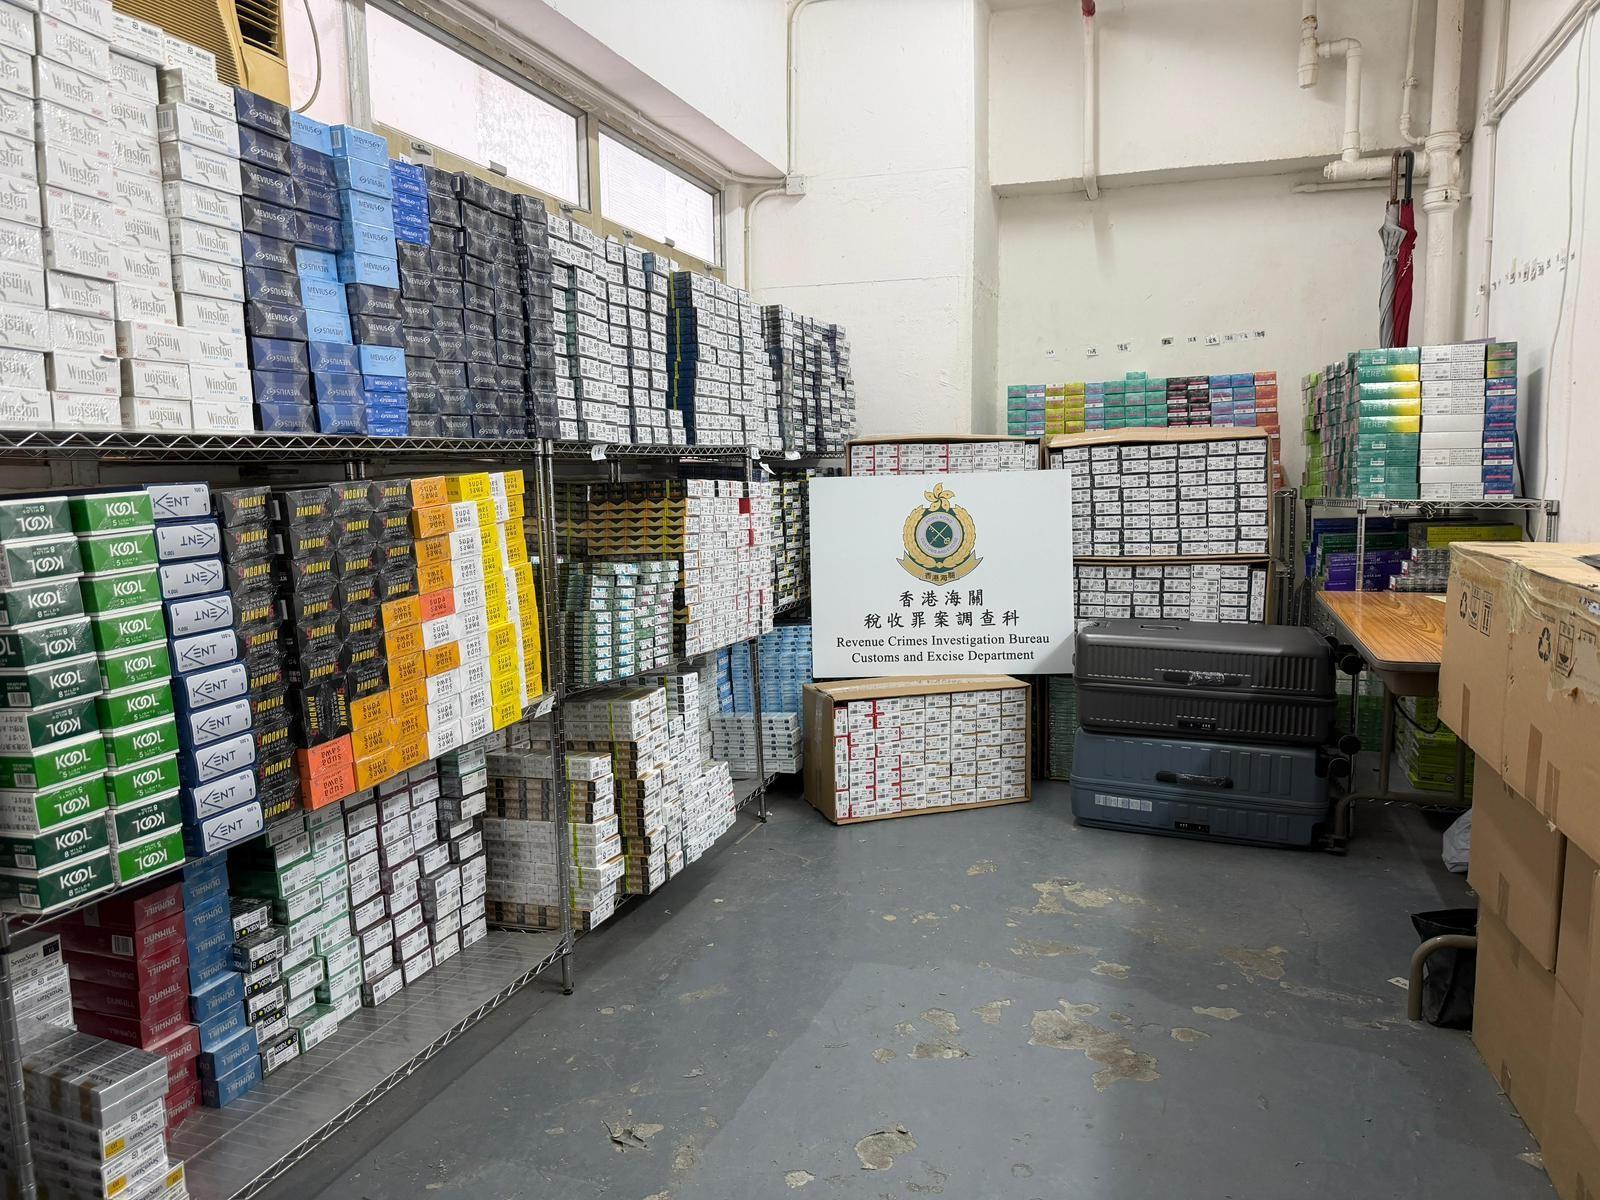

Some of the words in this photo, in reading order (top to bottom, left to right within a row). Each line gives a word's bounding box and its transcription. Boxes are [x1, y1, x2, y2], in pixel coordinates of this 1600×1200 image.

[52, 73, 94, 102] Winston
[112, 67, 148, 91] Winston
[111, 104, 148, 128] Winston
[259, 112, 282, 128] MEVIUS
[192, 116, 224, 139] Winston
[260, 148, 283, 163] MEVIUS
[59, 159, 99, 184] Winston
[251, 173, 275, 186] MEVIUS
[196, 193, 228, 214] Winston
[254, 208, 277, 221] MEVIUS
[125, 223, 161, 241] Winston
[196, 231, 229, 251] Winston
[124, 256, 160, 276] Winston
[199, 269, 232, 288] Winston
[61, 283, 101, 304] Winston
[197, 304, 230, 322] Winston
[146, 336, 180, 352] Winston
[200, 341, 233, 357] Winston
[67, 365, 108, 383] Winston
[205, 376, 238, 391] Winston
[207, 410, 239, 425] Winston
[106, 501, 139, 517] KOOL
[153, 493, 189, 516] KENT
[203, 502, 207, 511] 1
[17, 516, 53, 532] KOOL
[162, 531, 166, 540] 1
[180, 526, 216, 548] KENT
[110, 542, 142, 557] KOOL
[28, 556, 64, 573] KOOL
[165, 570, 169, 578] 1
[184, 564, 220, 585] KENT
[113, 580, 146, 596] KOOL
[28, 589, 66, 608] KOOL
[899, 589, 983, 607] 香港海關
[175, 608, 179, 616] 1
[194, 600, 229, 621] KENT
[119, 618, 151, 634] KOOL
[40, 638, 76, 655] KOOL
[837, 637, 884, 647] Revenue
[888, 636, 928, 646] Crimes
[931, 635, 1005, 647] Investigation
[1009, 634, 1049, 643] Bureau
[181, 644, 217, 665] KENT
[230, 648, 234, 656] 1
[852, 653, 900, 663] Customs
[904, 652, 923, 662] and
[927, 651, 964, 661] Excise
[968, 650, 1034, 663] Department
[125, 656, 156, 673] KOOL
[50, 671, 85, 689] KOOL
[193, 679, 227, 700] KENT
[127, 694, 159, 712] KOOL
[46, 718, 81, 737] KOOL
[197, 715, 232, 736] KENT
[133, 731, 164, 749] KOOL
[56, 749, 91, 770] KOOL
[202, 751, 236, 772] KENT
[249, 752, 252, 760] 1
[133, 768, 165, 788] KOOL
[200, 787, 235, 808] KENT
[249, 788, 252, 796] 1
[54, 795, 90, 816] KOOL
[132, 812, 165, 833] KOOL
[209, 819, 243, 841] KENT
[256, 820, 259, 828] 1
[56, 828, 92, 850] KOOL
[135, 850, 167, 870] KOOL
[60, 867, 97, 889] KOOL
